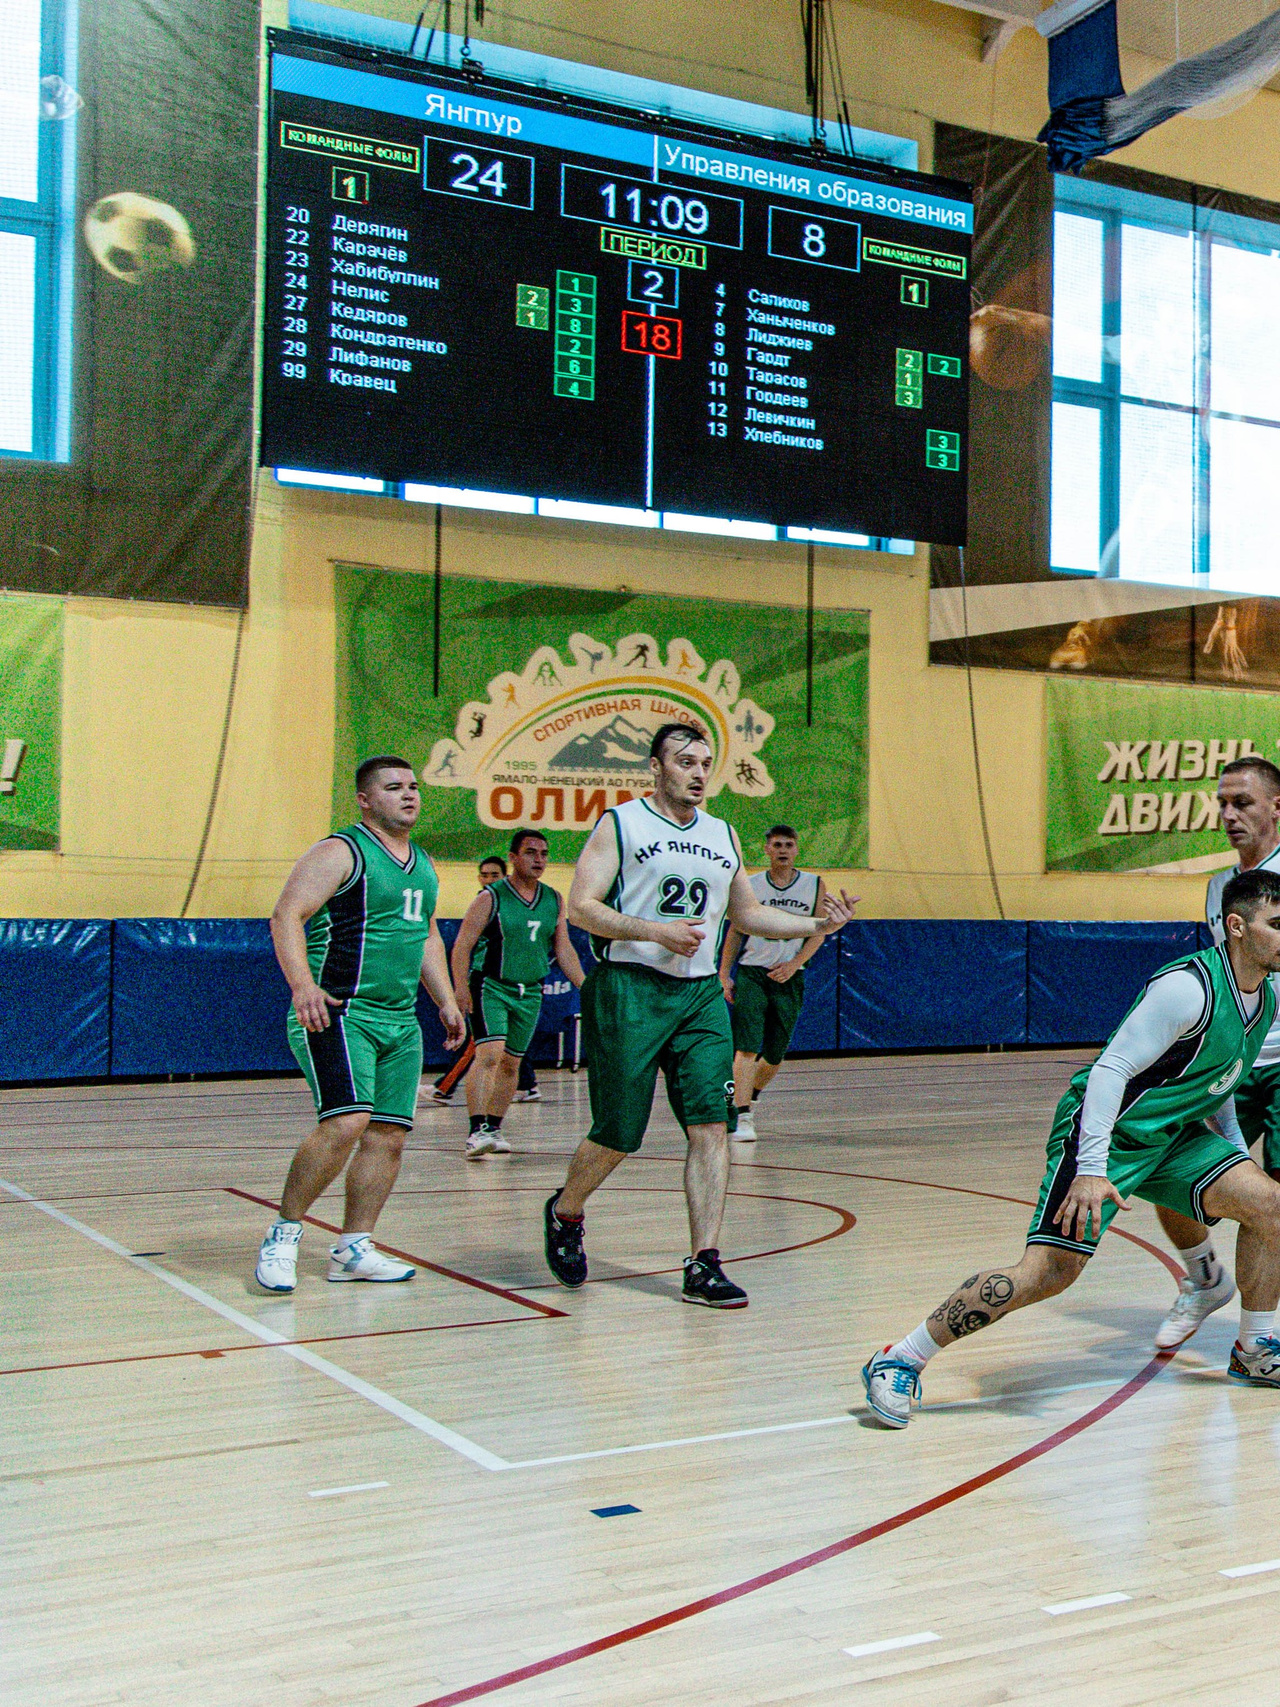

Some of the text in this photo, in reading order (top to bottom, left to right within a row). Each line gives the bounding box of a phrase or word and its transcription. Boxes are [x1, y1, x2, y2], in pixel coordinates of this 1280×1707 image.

[425, 93, 522, 137] Янгпур
[288, 130, 373, 156] КОМАНДНЫЕ
[342, 176, 356, 199] 1
[451, 153, 508, 197] 24
[665, 143, 966, 228] Управления образования
[601, 183, 709, 235] 11:09
[286, 206, 408, 242] 20 Дерягин
[286, 228, 408, 263] 22 Карачёв
[609, 234, 698, 266] ПЕРИОД
[802, 224, 826, 258] 8
[285, 250, 440, 290] 23 Хабибуллин
[285, 272, 390, 303] 24 Нелис
[527, 290, 539, 306] 2
[571, 278, 579, 292] 1
[643, 270, 664, 299] 2
[715, 283, 810, 313] 4 Салихов
[908, 283, 919, 303] 1
[284, 294, 408, 328] 27 Кедяров
[528, 311, 535, 326] 1
[570, 298, 582, 313] 3
[715, 302, 726, 317] 7
[284, 316, 448, 355] 28 Кондратенко
[570, 318, 581, 333] 8
[633, 321, 672, 351] 18
[714, 322, 814, 351] 8 Лиджиев
[283, 340, 412, 373] 29 Лифанов
[570, 339, 581, 354] 2
[714, 342, 792, 368] 9 Гардт
[569, 359, 581, 374] 6
[708, 361, 808, 389] 10 Тарасов
[904, 354, 915, 368] 2
[939, 360, 950, 374] 2
[282, 361, 398, 394] 99 Кравец
[569, 381, 580, 397] 4
[904, 373, 913, 386] 1
[708, 381, 809, 409] 11 Гордеев
[903, 391, 913, 405] 3
[707, 402, 816, 431] 12 Левичкин
[707, 421, 825, 451] 13 Хлебников
[938, 436, 948, 449] 3
[938, 454, 948, 468] 3
[533, 698, 642, 742] СПОРТИВНАЯ
[505, 760, 537, 772] 1995
[492, 774, 605, 787] ЯМАЛО-НЕНЕЦКИЙ
[606, 778, 624, 788] АО
[635, 841, 731, 870] НК ЯНГПУР
[403, 888, 423, 922] 11
[657, 874, 710, 919] 29
[769, 898, 810, 912] ЯНГПУР
[527, 921, 541, 941] 7
